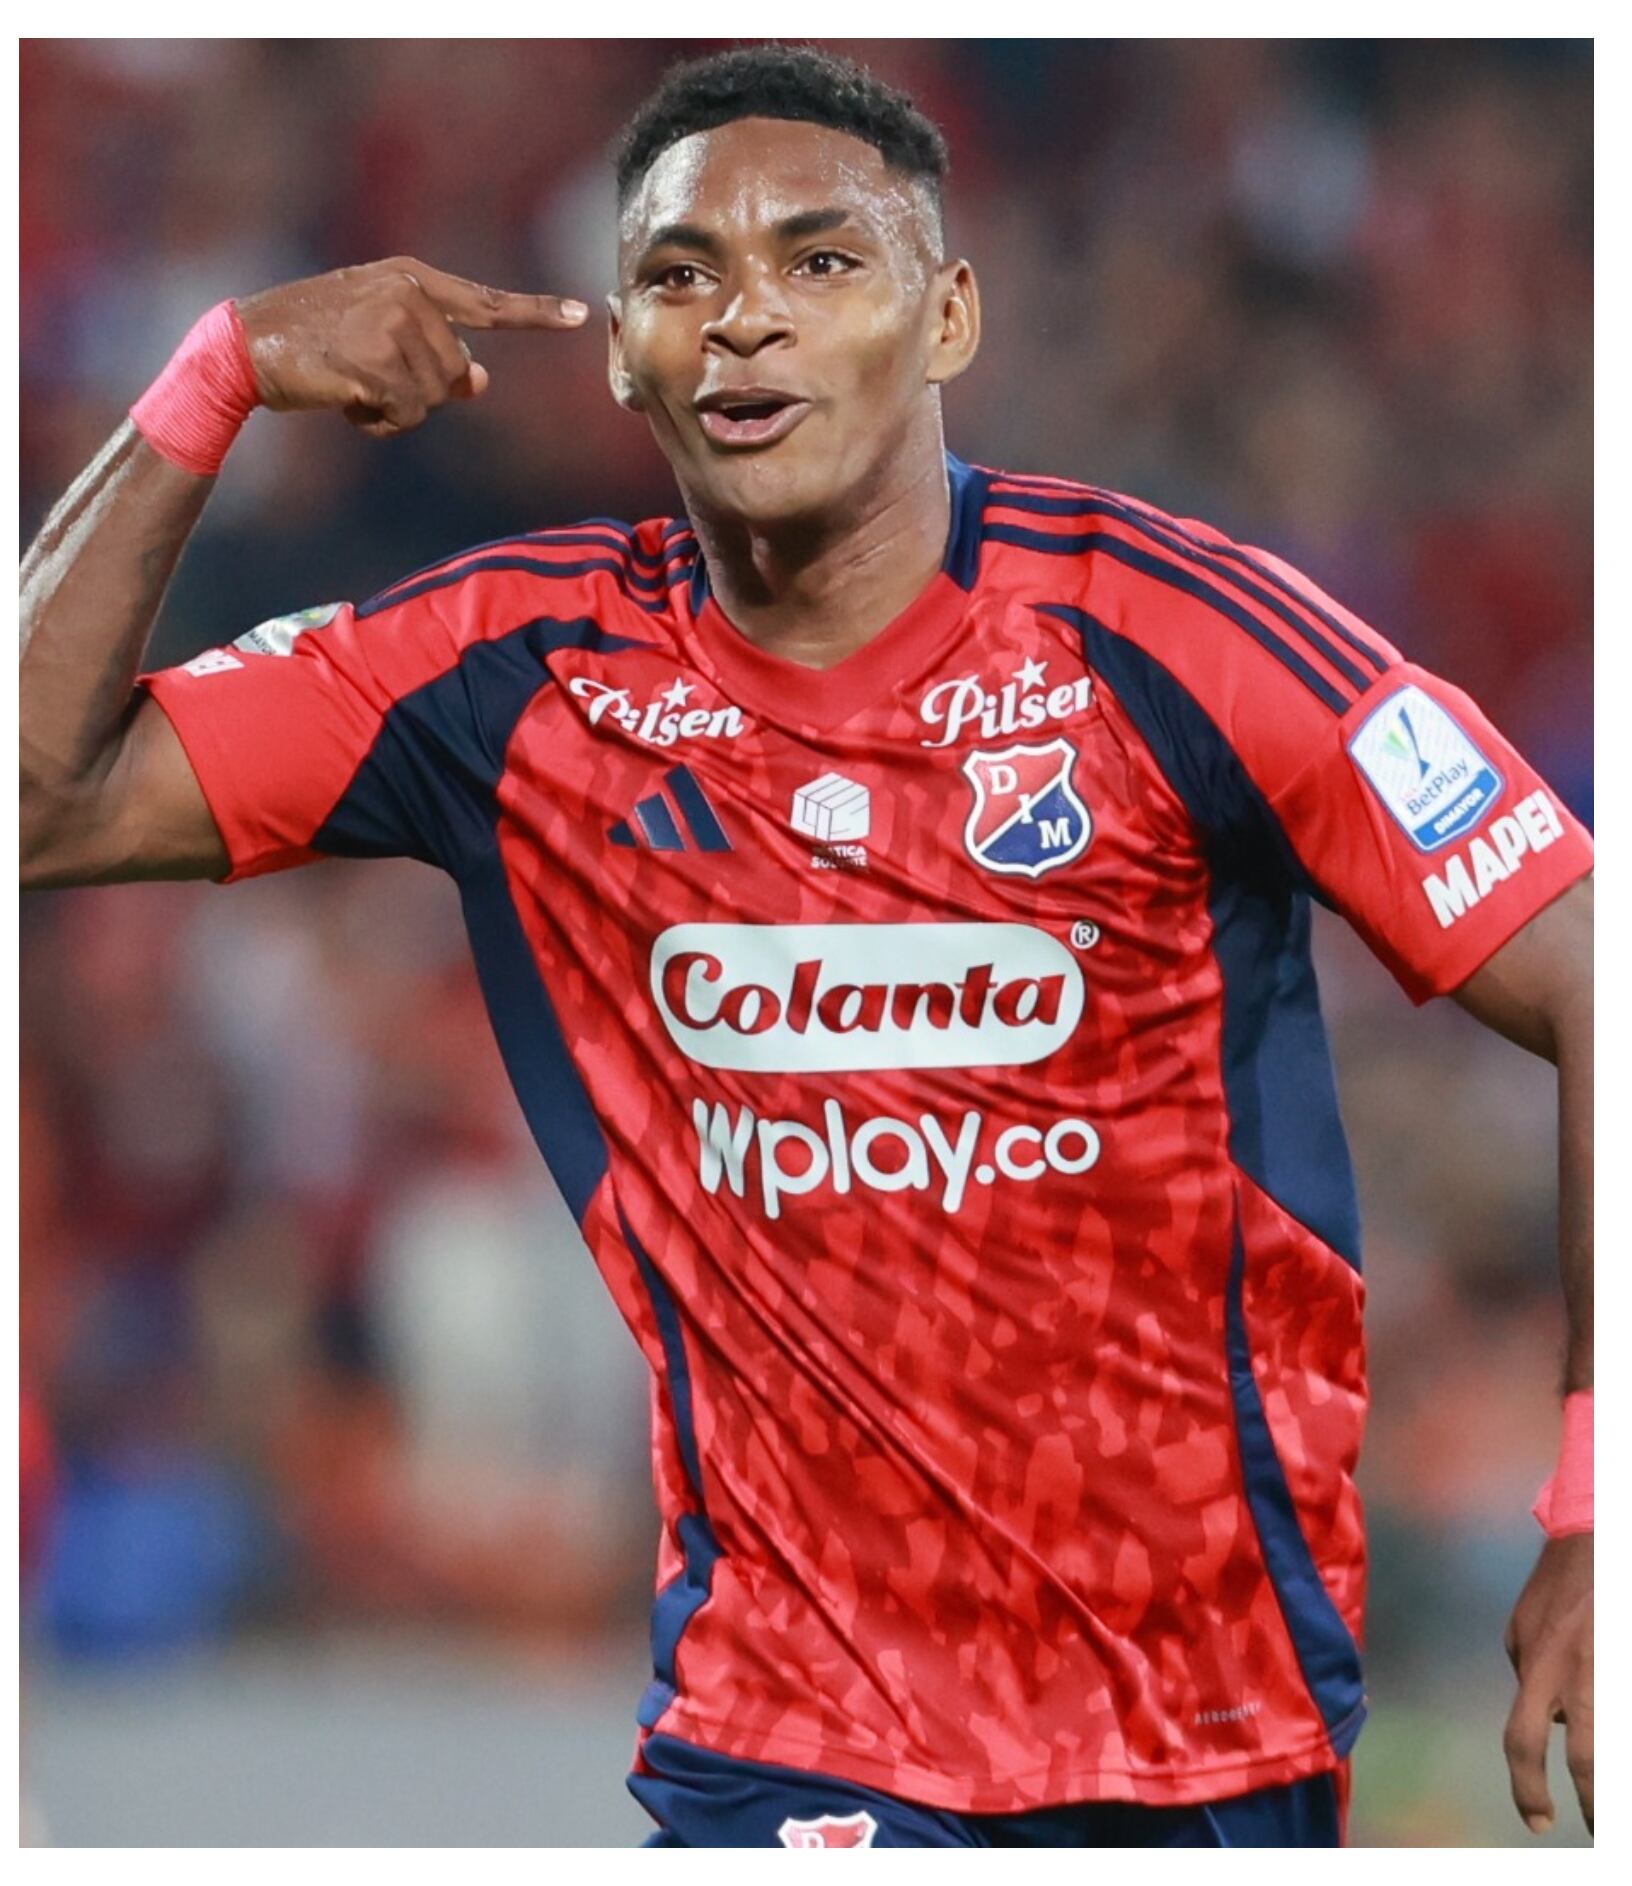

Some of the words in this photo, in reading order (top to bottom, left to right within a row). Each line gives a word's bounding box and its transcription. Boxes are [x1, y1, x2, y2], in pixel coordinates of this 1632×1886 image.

[1406, 757, 1469, 817] BetPlay
[1421, 788, 1564, 929] MAPEI
[662, 951, 1066, 1036] Colanta
[692, 1097, 1100, 1220] Wplay.co
